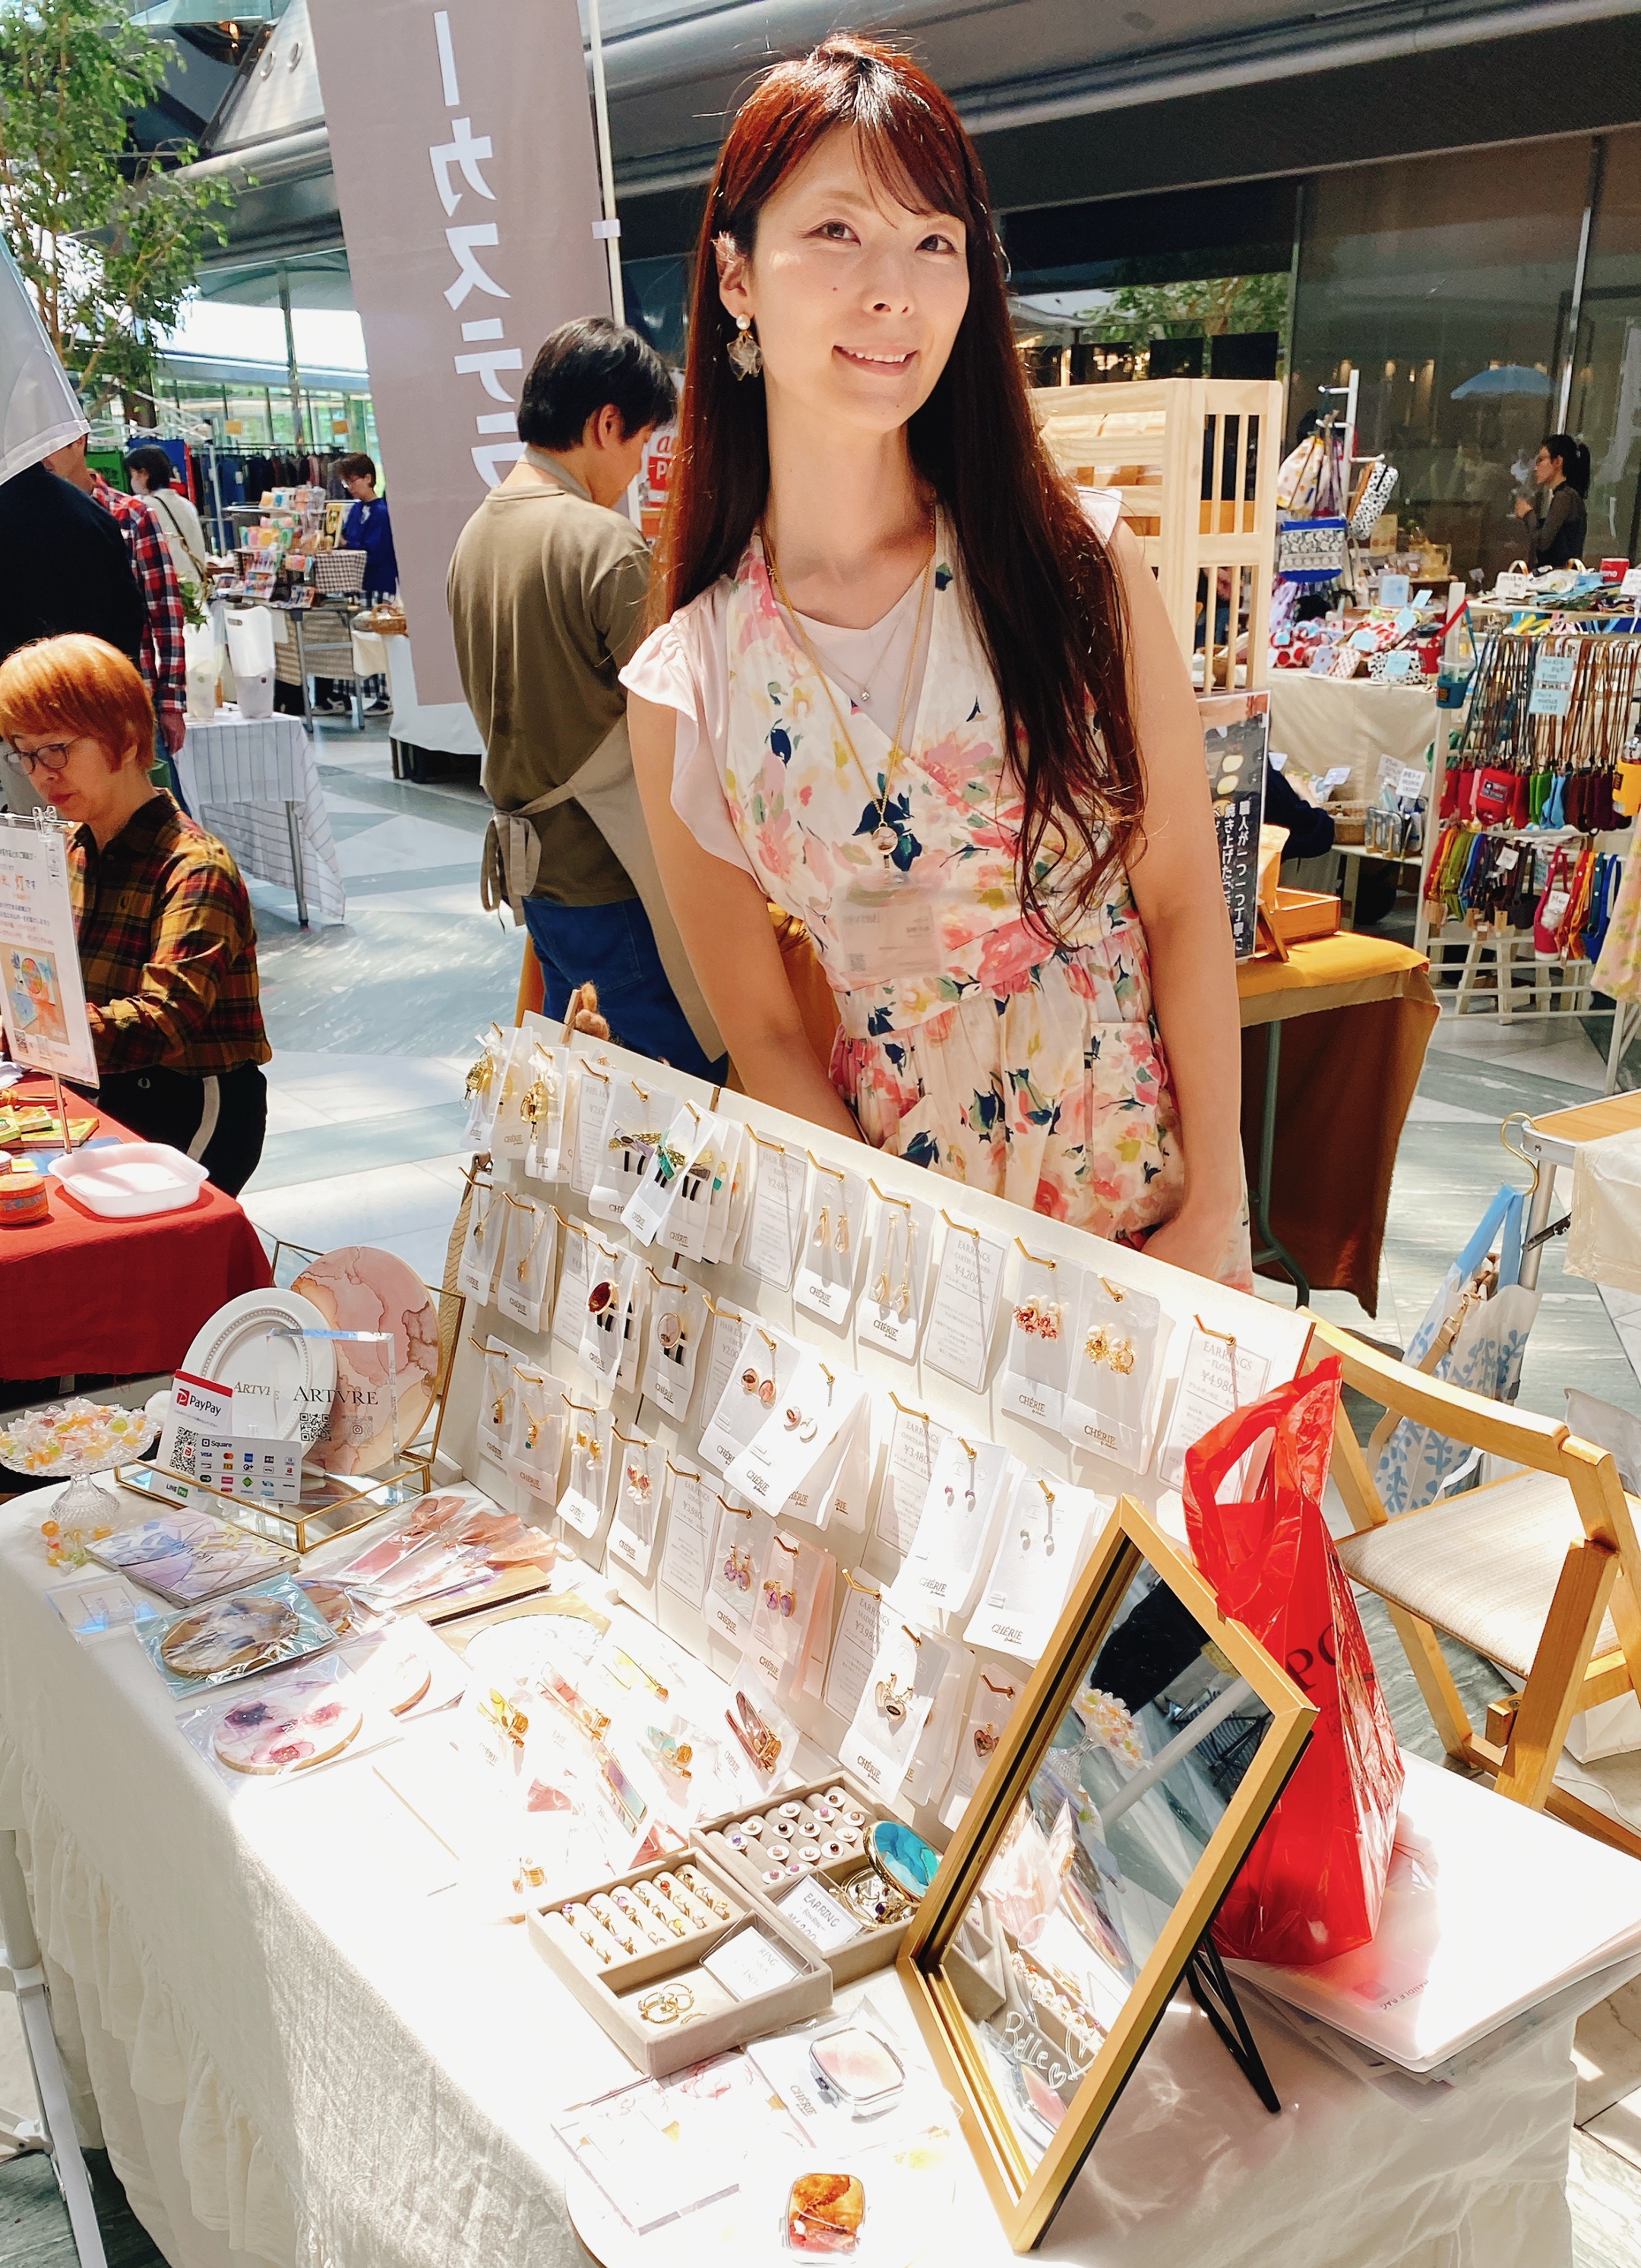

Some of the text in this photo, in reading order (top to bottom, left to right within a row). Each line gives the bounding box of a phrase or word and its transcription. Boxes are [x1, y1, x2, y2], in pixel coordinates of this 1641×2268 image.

[609, 1204, 625, 1215] CHÉ
[957, 1240, 991, 1263] EARRINGS
[809, 1285, 831, 1303] CHÉRIE
[733, 1325, 748, 1338] ELAS
[873, 1317, 899, 1338] CHÉRIE
[1203, 1340, 1252, 1371] EARRINGS
[1211, 1359, 1240, 1379] FLOWER
[189, 1394, 222, 1417] PayPay
[294, 1385, 378, 1406] ARTVRE
[1019, 1394, 1045, 1413] CHÉRIE
[906, 1421, 940, 1445] EARRINGS
[1083, 1424, 1116, 1445] CHÉRIE
[210, 1440, 232, 1448] Square
[716, 1445, 735, 1462] CHÉRI
[166, 1483, 178, 1493] LINE
[684, 1480, 710, 1502] EARRINGS
[746, 1470, 770, 1492] CHÉRIE
[716, 1610, 736, 1631] CHÉRIE
[859, 1598, 890, 1626] EARRINGS
[992, 1623, 1023, 1641] CHÉRIE
[858, 1755, 881, 1780] CHÉRIE
[803, 1892, 840, 1928] EARRING
[758, 1947, 779, 1967] RING
[997, 2011, 1048, 2071] Belle
[790, 2085, 817, 2117] CHÉRIE
